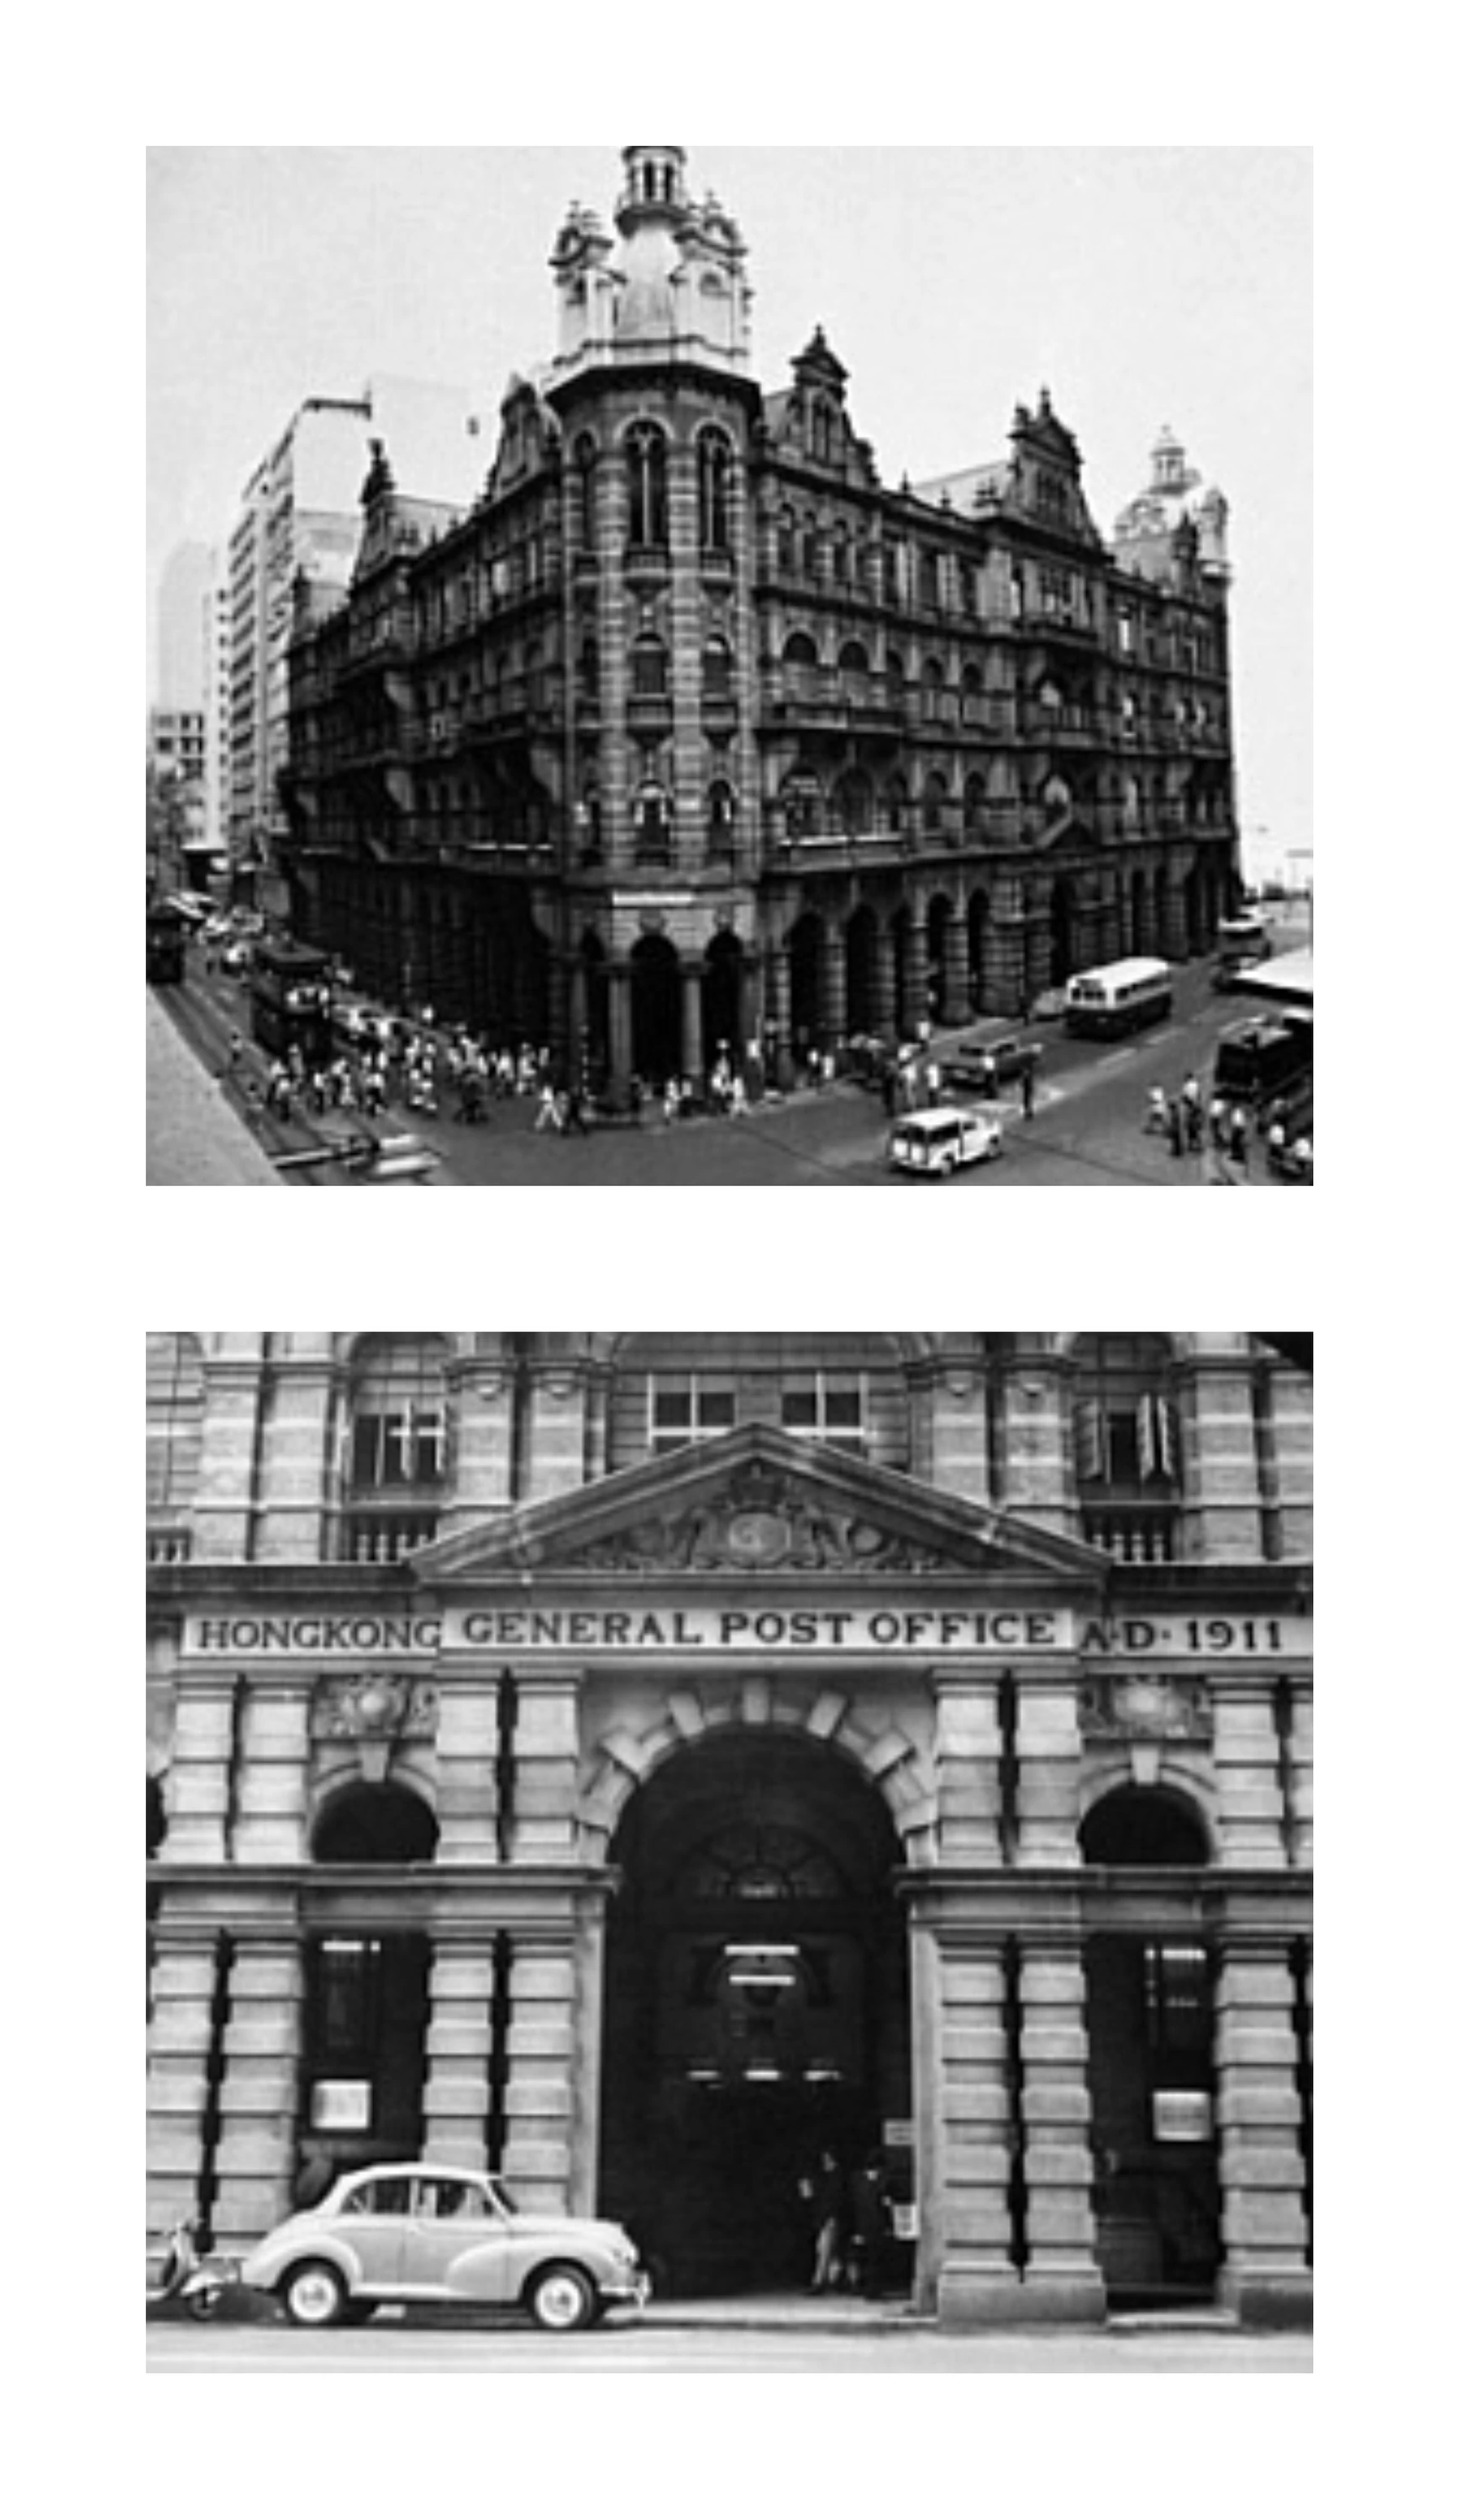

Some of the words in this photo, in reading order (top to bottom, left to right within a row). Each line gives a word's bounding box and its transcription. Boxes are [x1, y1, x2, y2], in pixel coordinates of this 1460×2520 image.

[198, 1620, 441, 1648] HONGKONG
[462, 1612, 701, 1644] GENERAL
[719, 1612, 853, 1644] POST
[867, 1612, 1056, 1644] OFFICE
[1186, 1620, 1281, 1651] 1911
